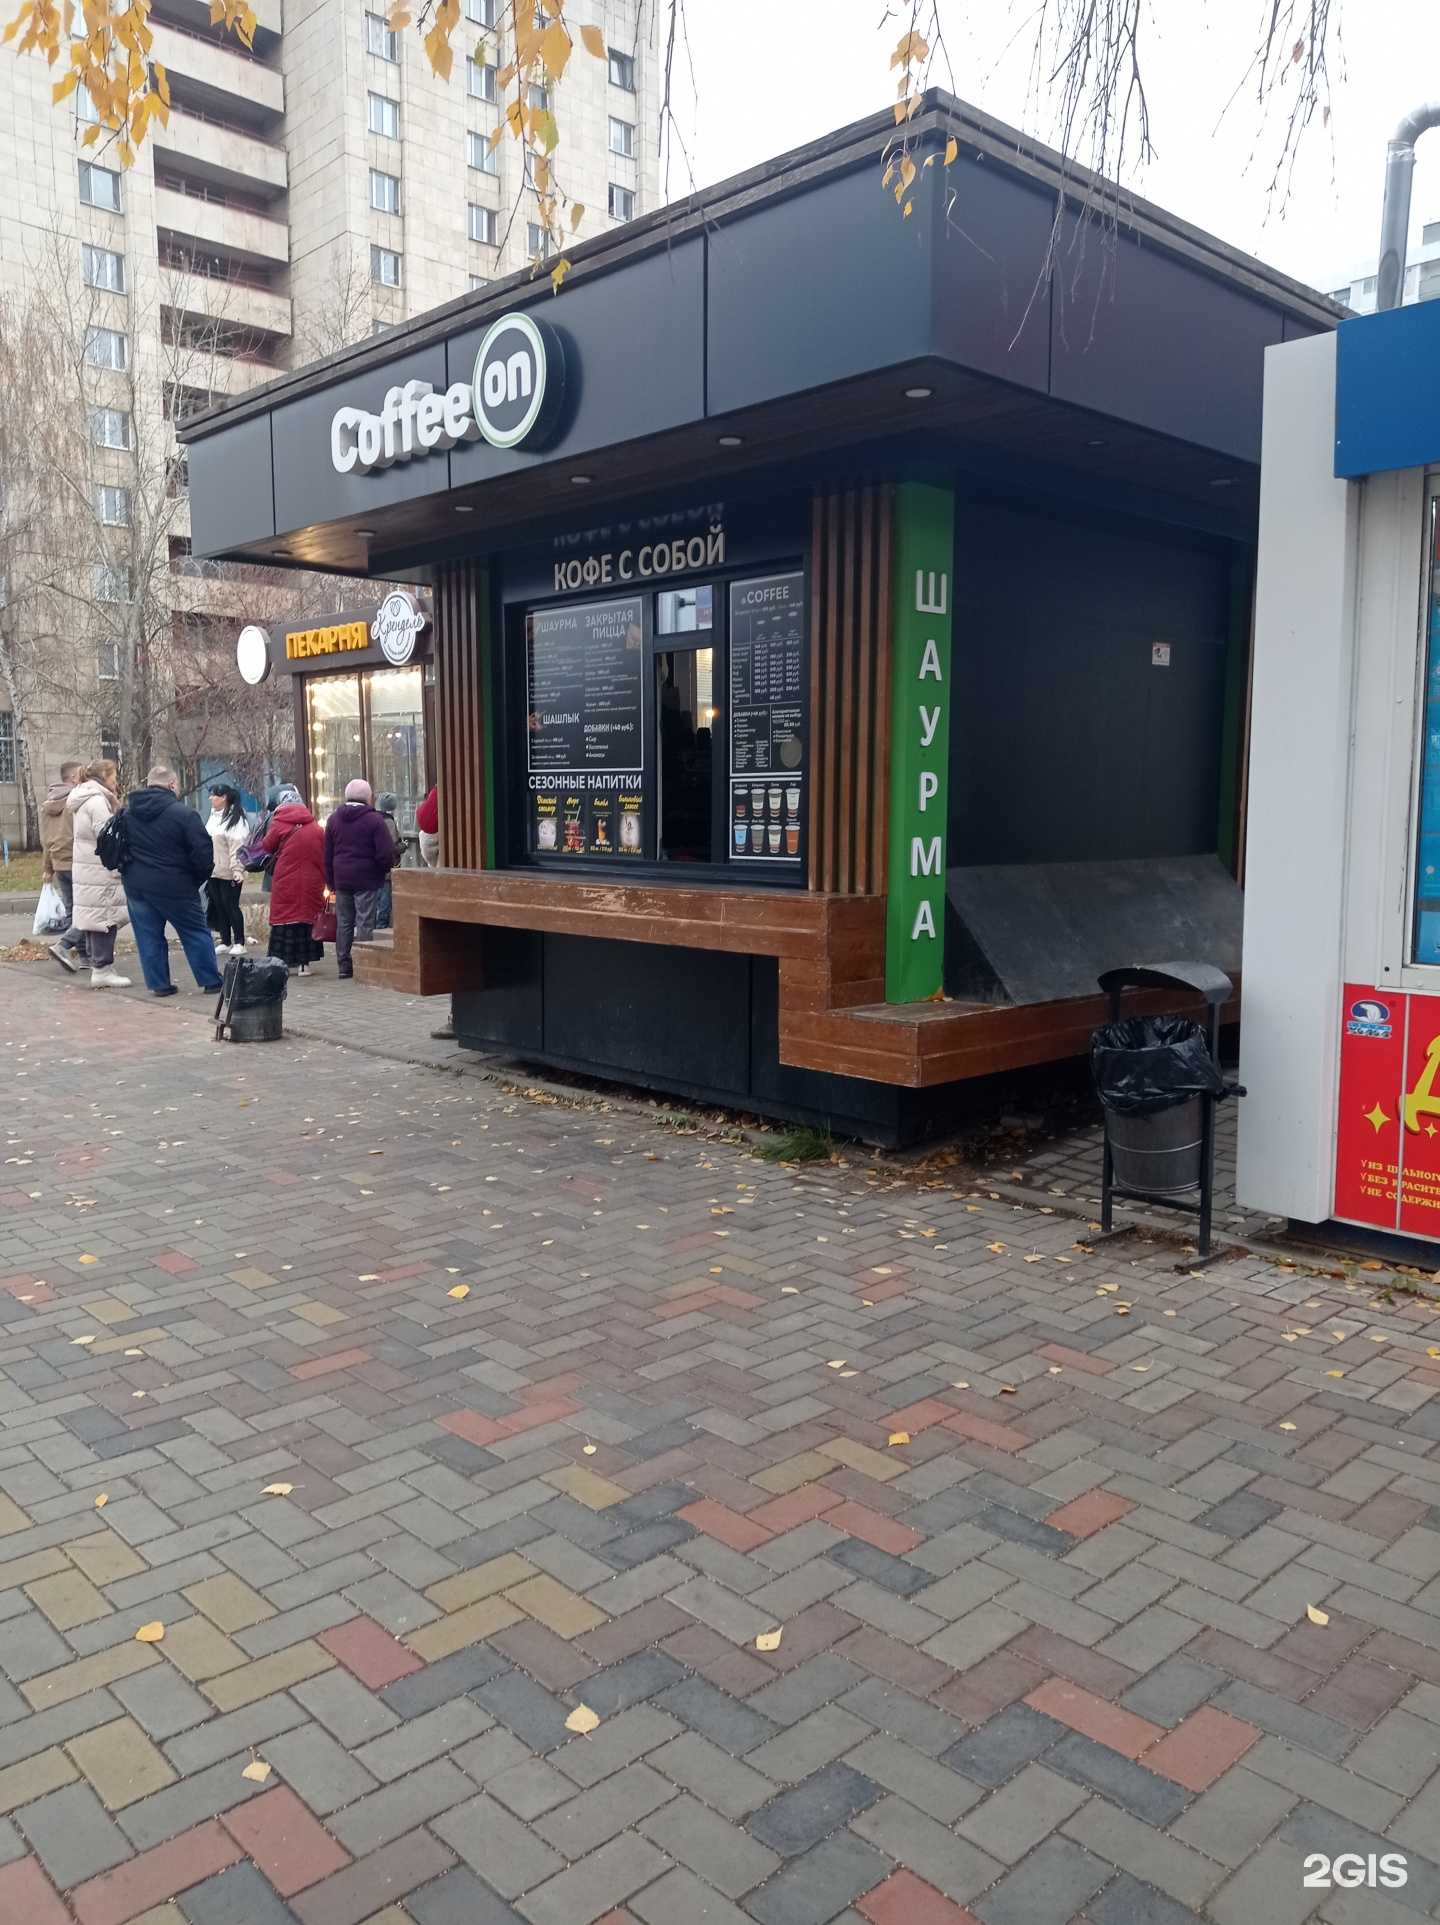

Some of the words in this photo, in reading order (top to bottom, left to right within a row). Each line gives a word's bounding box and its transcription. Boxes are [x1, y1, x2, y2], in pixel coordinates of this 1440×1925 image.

[331, 379, 478, 473] Coffee
[484, 350, 531, 408] on
[554, 556, 612, 591] КОФЕ
[618, 550, 633, 580] С
[638, 523, 725, 576] СОБОЙ
[747, 585, 789, 604] COFFEE
[541, 616, 578, 633] ШАУРМА
[584, 609, 634, 628] ЗАКРЫТАЯ
[286, 621, 368, 660] ПЕКАРНЯ
[592, 624, 626, 640] ПИЦЦА
[543, 712, 580, 725] ШАШЛЫК
[910, 569, 948, 941] ШАУРМА
[528, 775, 586, 789] СЕЗОННЫЕ
[588, 774, 642, 789] НАПИТКИ
